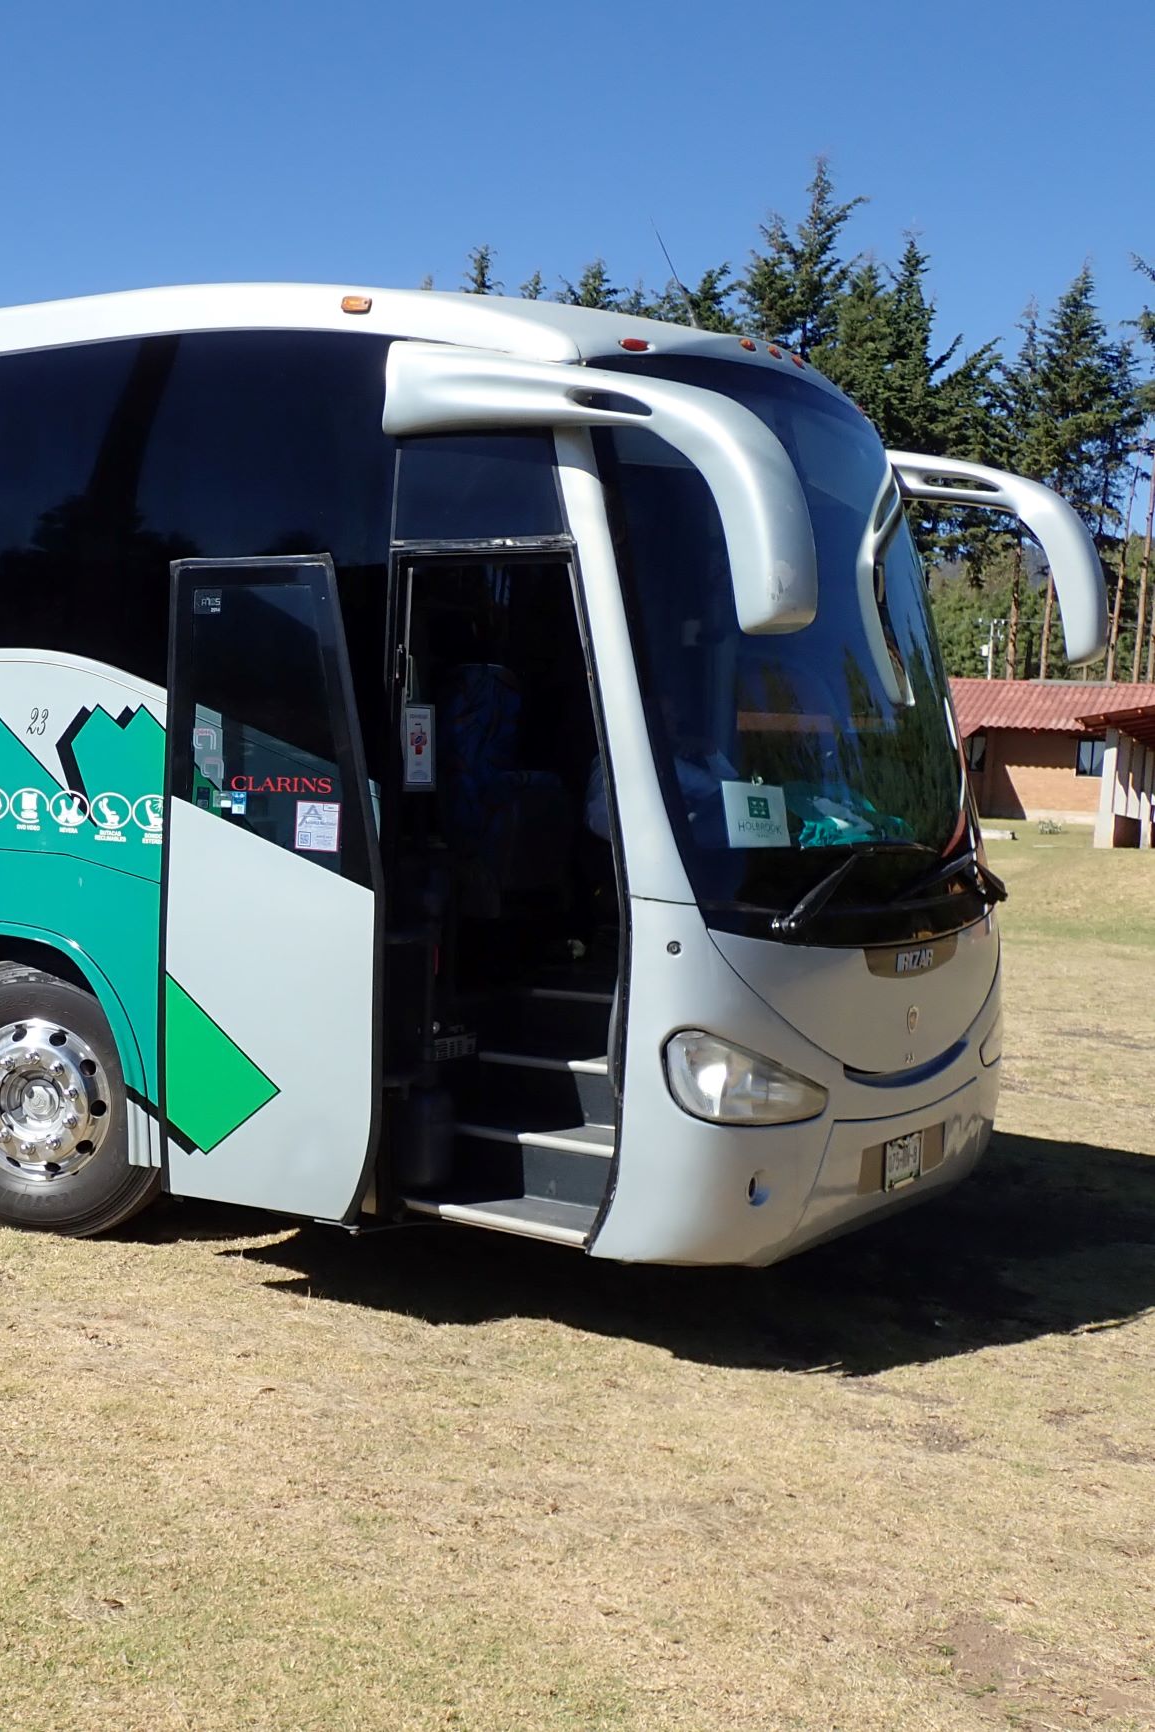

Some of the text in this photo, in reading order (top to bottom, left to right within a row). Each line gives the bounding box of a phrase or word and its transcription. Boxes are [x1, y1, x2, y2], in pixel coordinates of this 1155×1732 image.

[26, 707, 49, 736] 23
[231, 775, 333, 794] CLARINS
[895, 949, 934, 972] IRIZAR
